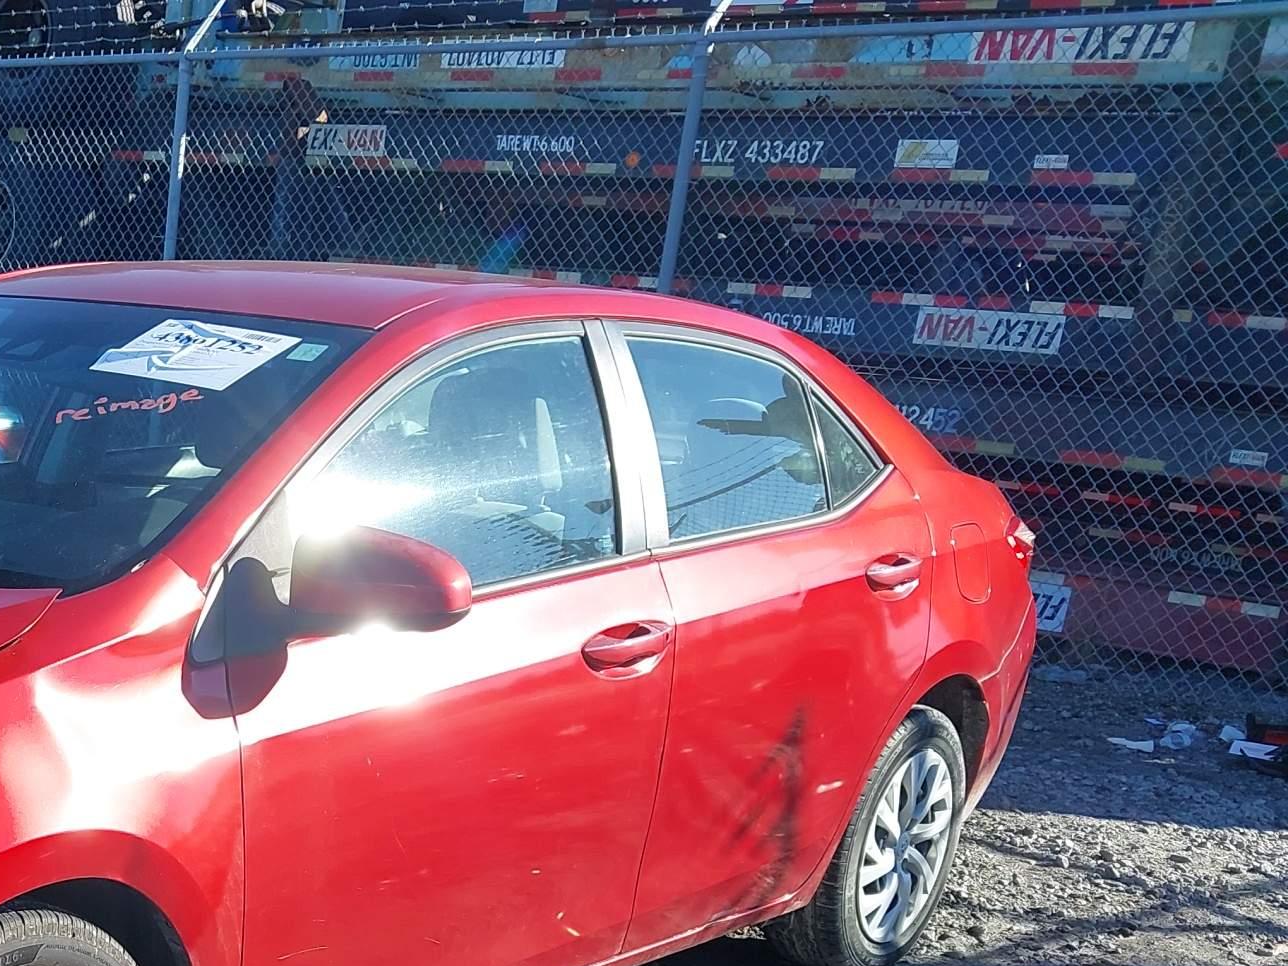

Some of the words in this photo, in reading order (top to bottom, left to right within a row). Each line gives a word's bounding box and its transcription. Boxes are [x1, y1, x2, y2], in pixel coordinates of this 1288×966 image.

[973, 22, 1185, 61] FLEXI-VAN
[744, 139, 825, 164] 433487
[918, 312, 1062, 350] FLEXI-VAN
[55, 388, 205, 424] reimage
[1032, 593, 1067, 621] FL
